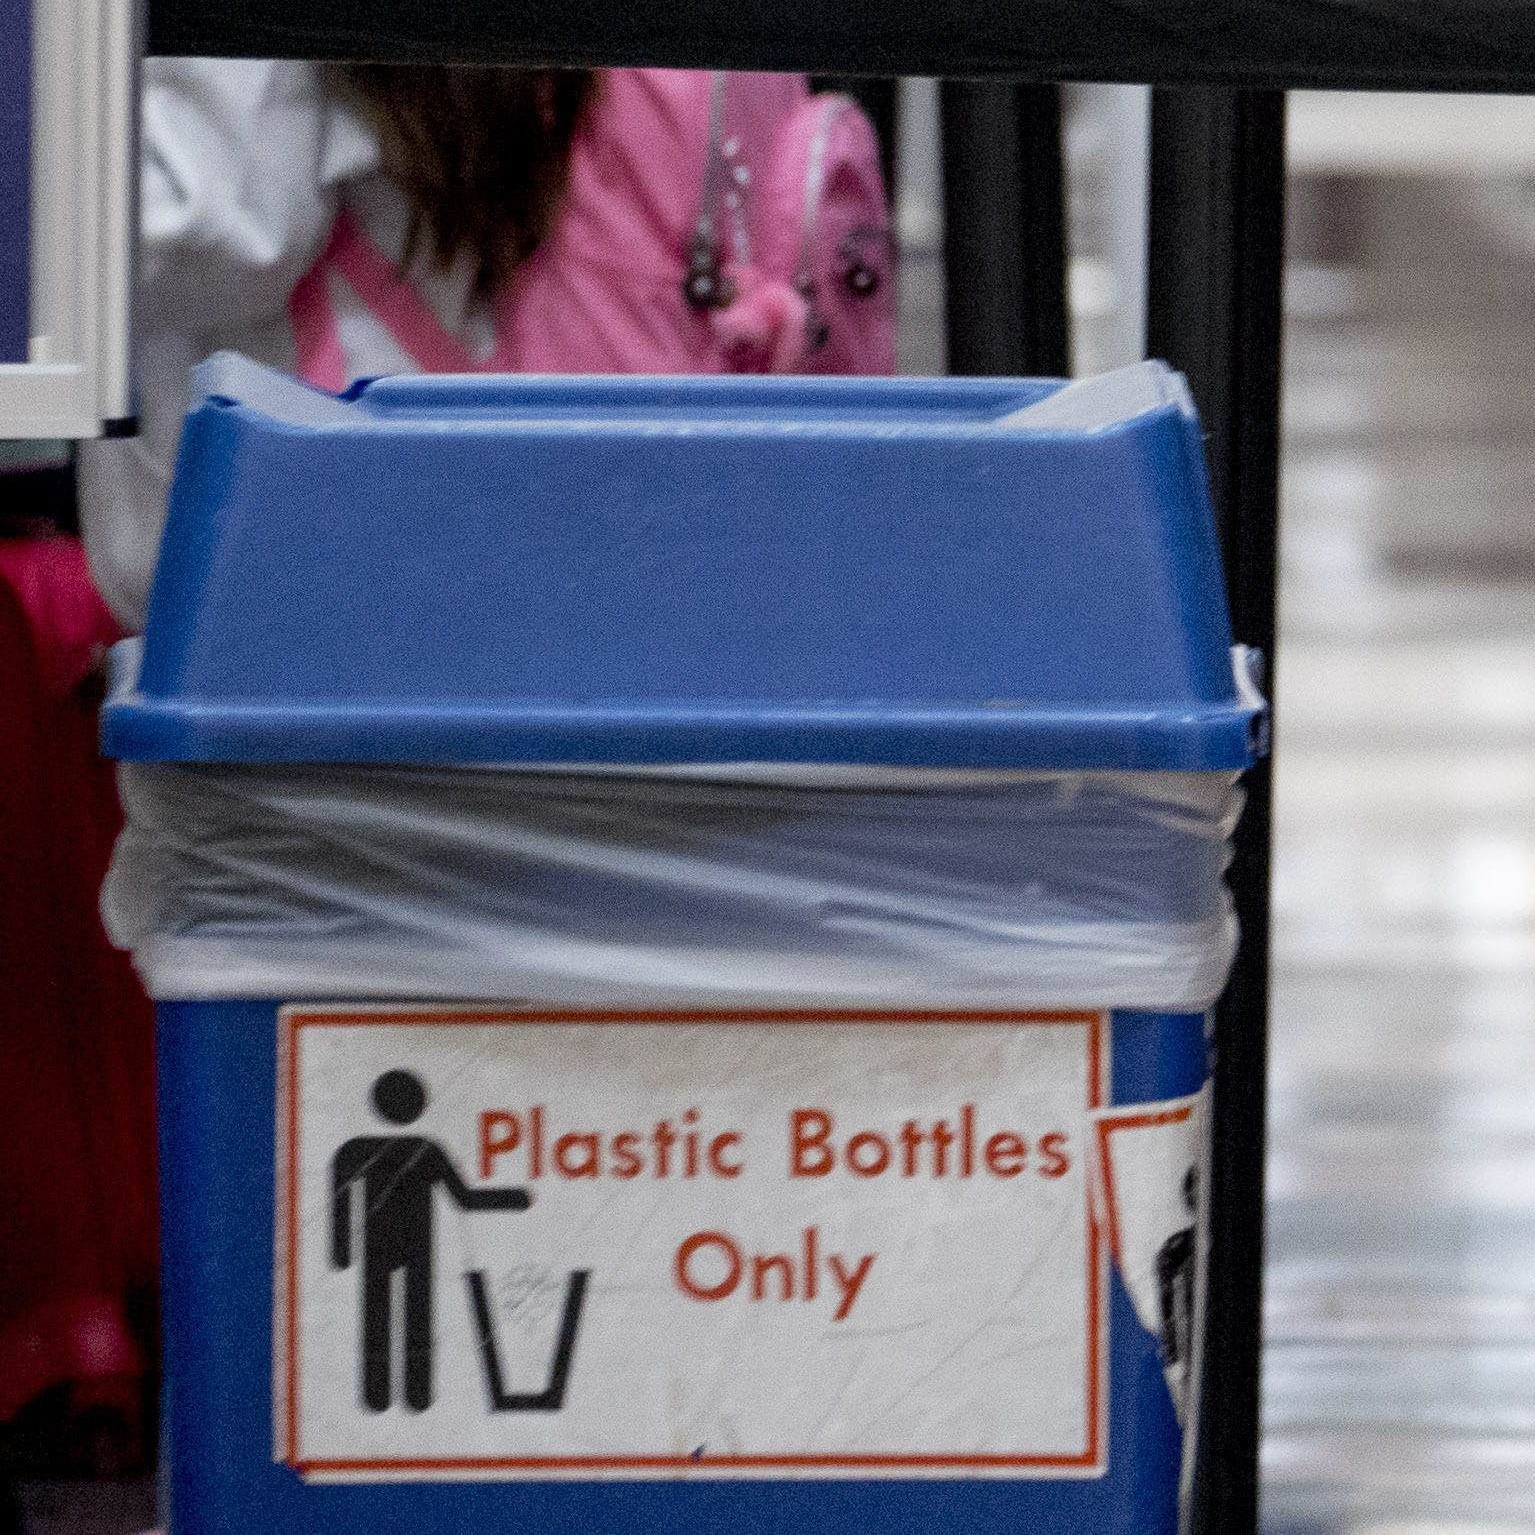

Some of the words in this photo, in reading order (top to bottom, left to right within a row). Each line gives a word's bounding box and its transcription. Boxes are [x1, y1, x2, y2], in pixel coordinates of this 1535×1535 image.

[476, 1103, 746, 1181] Plastic
[788, 1104, 1071, 1181] Bottles
[672, 1227, 879, 1323] Only
